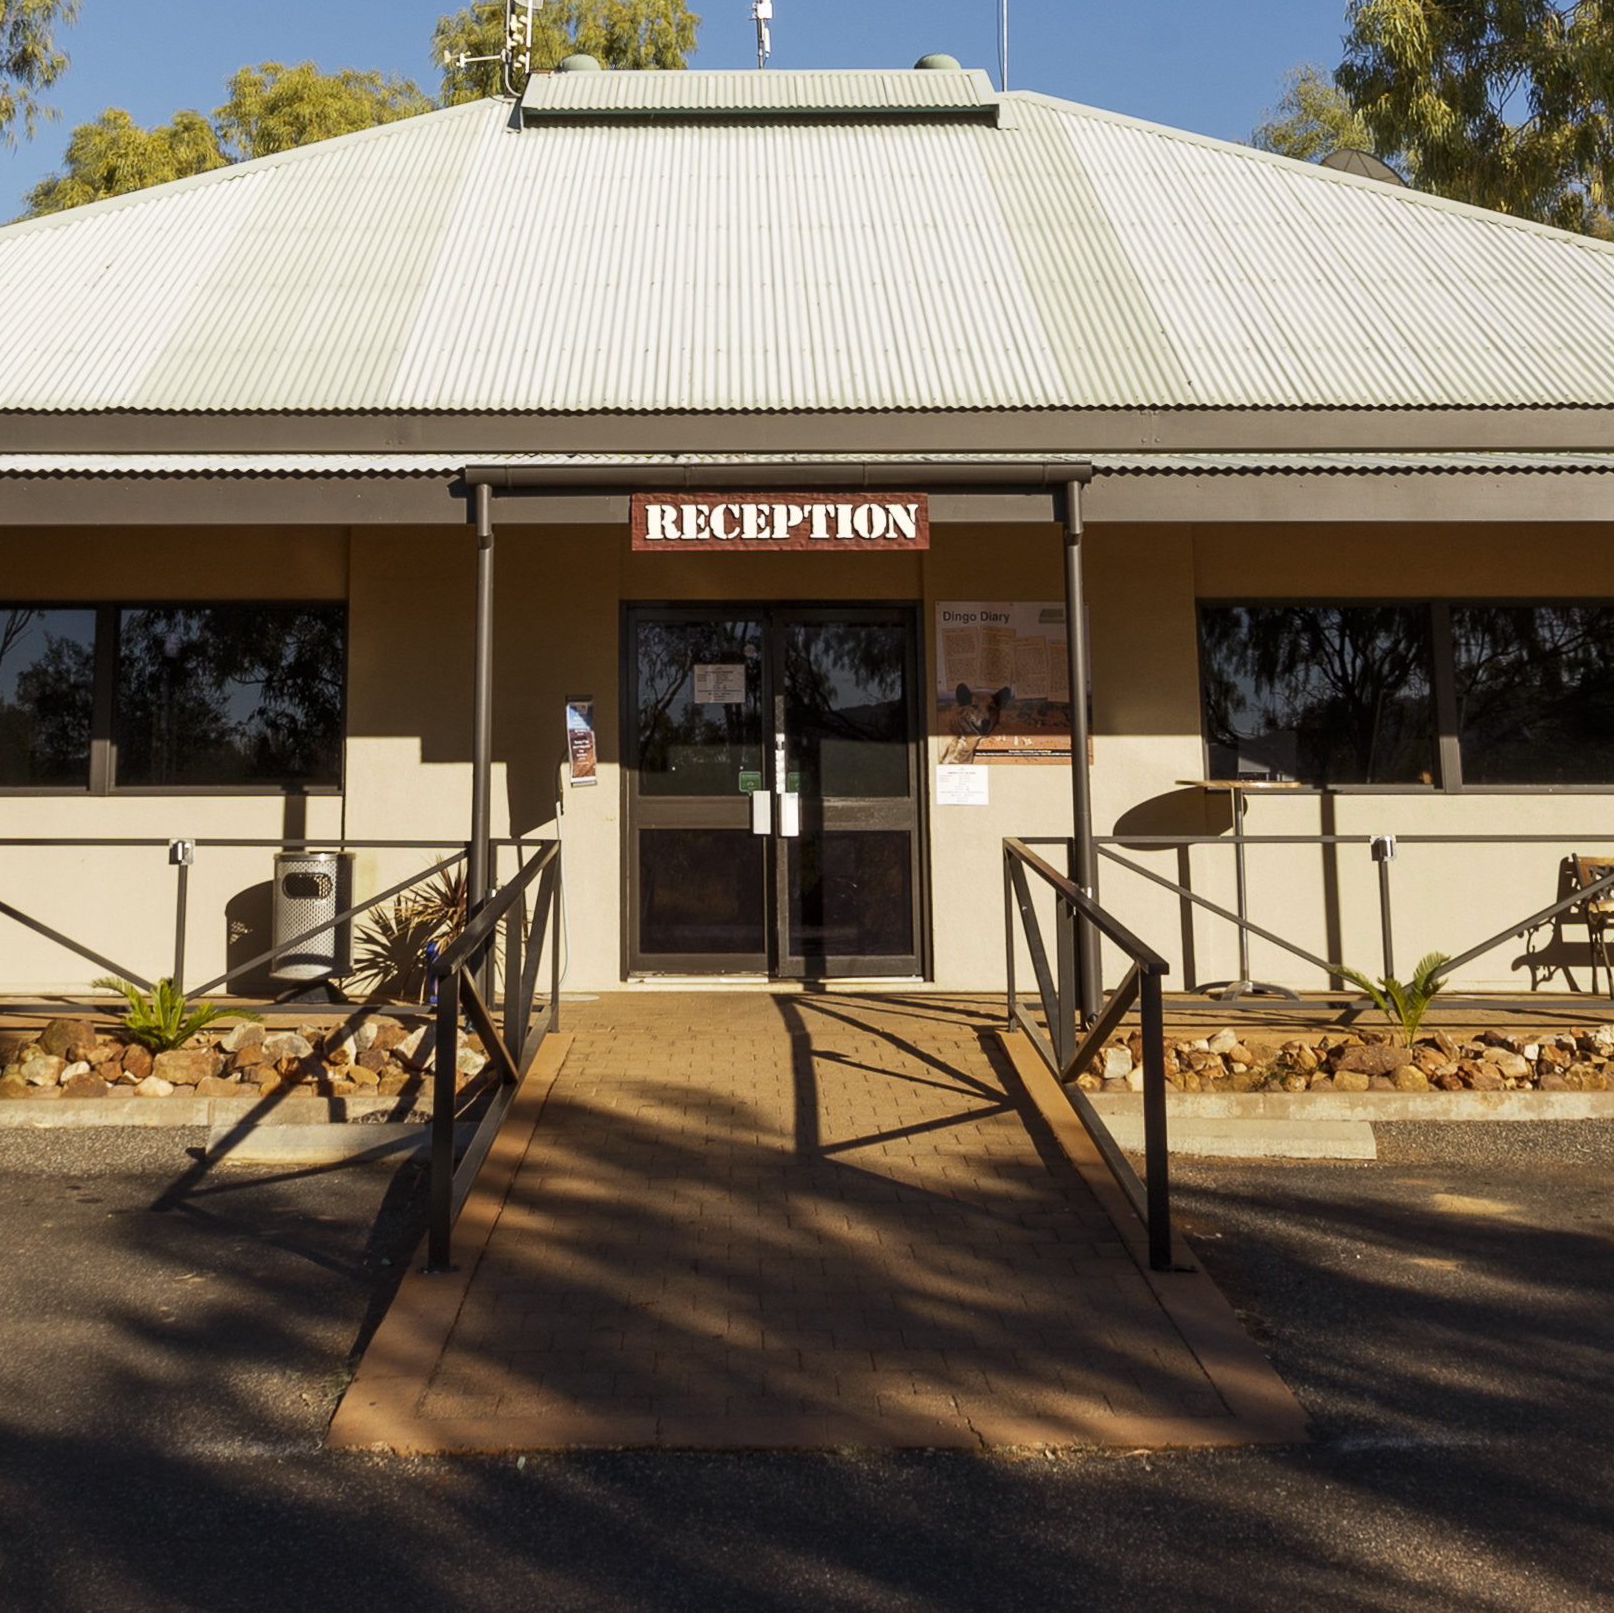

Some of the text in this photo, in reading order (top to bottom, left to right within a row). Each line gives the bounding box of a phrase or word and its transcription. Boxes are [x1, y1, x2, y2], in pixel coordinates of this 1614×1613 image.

[645, 503, 919, 540] RECEPTION
[943, 610, 1010, 625] Dingo Diary
